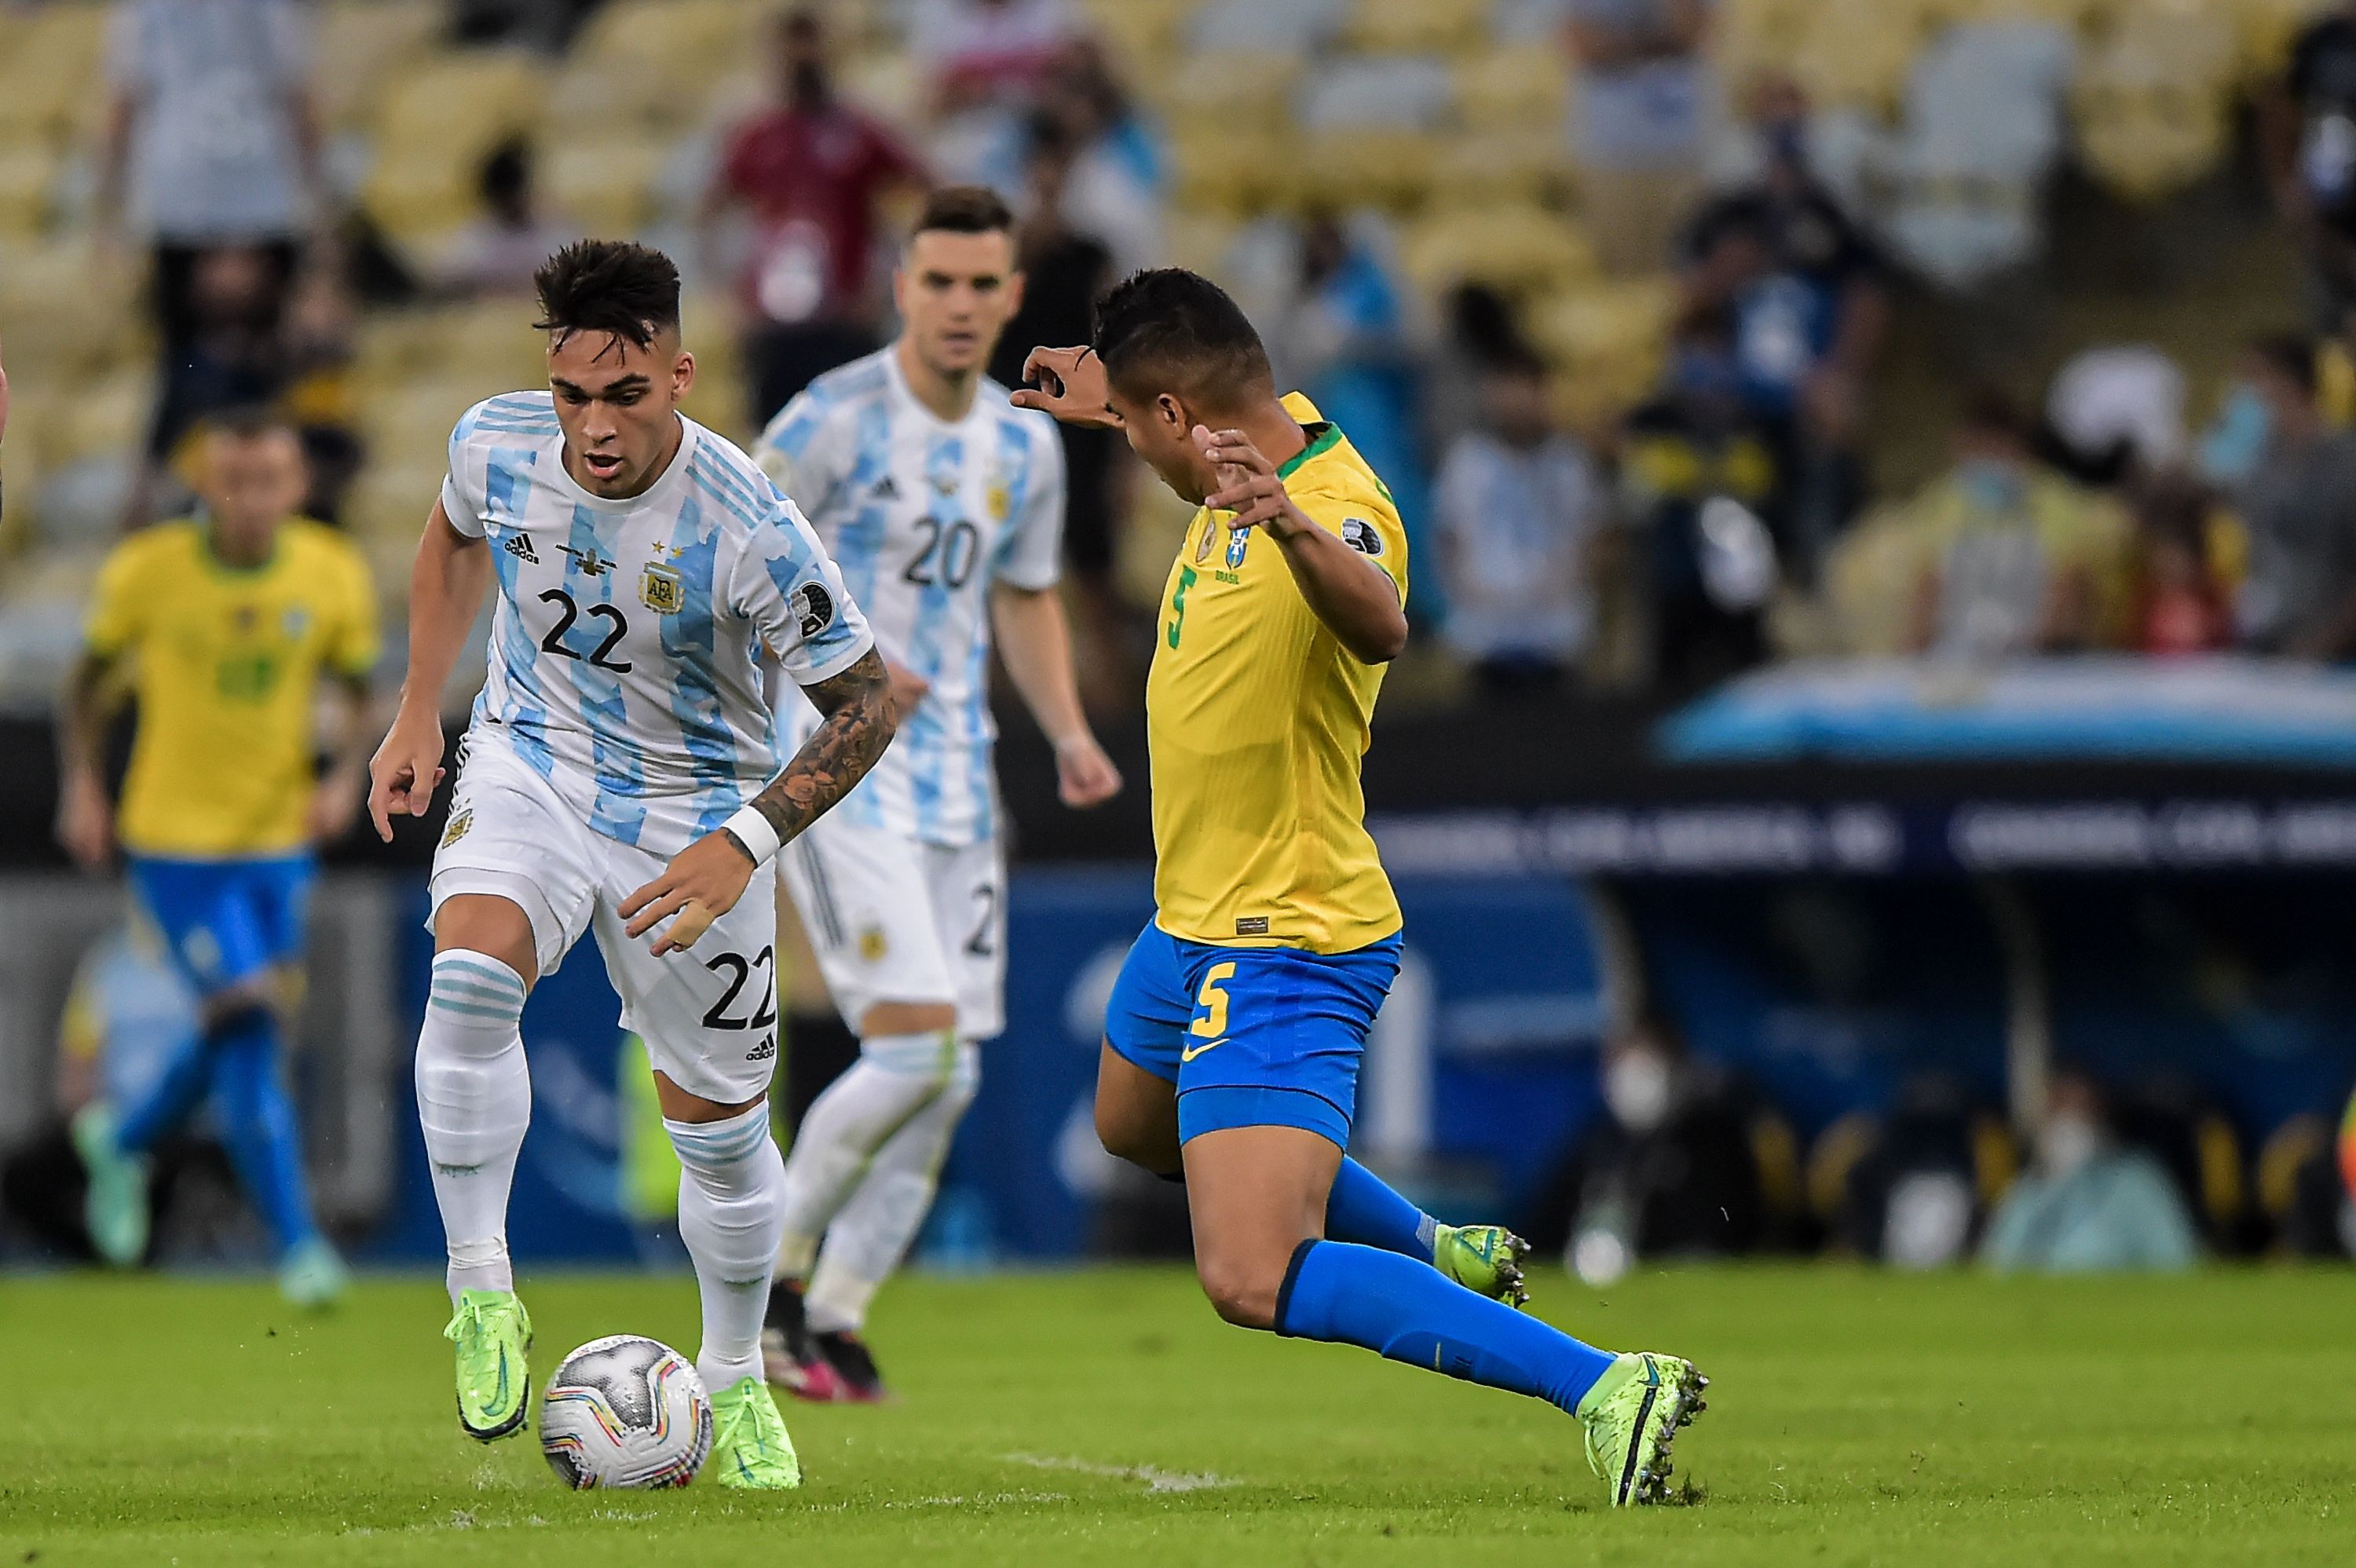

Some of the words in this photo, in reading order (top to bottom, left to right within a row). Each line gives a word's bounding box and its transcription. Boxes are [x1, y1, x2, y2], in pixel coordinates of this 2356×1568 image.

[504, 542, 540, 565] adidas
[902, 517, 978, 588] 20
[1215, 569, 1239, 585] BRASIL
[537, 589, 632, 674] 22
[1168, 564, 1197, 651] 5
[965, 883, 993, 956] 2
[701, 945, 777, 1031] 22
[1190, 961, 1237, 1039] 5
